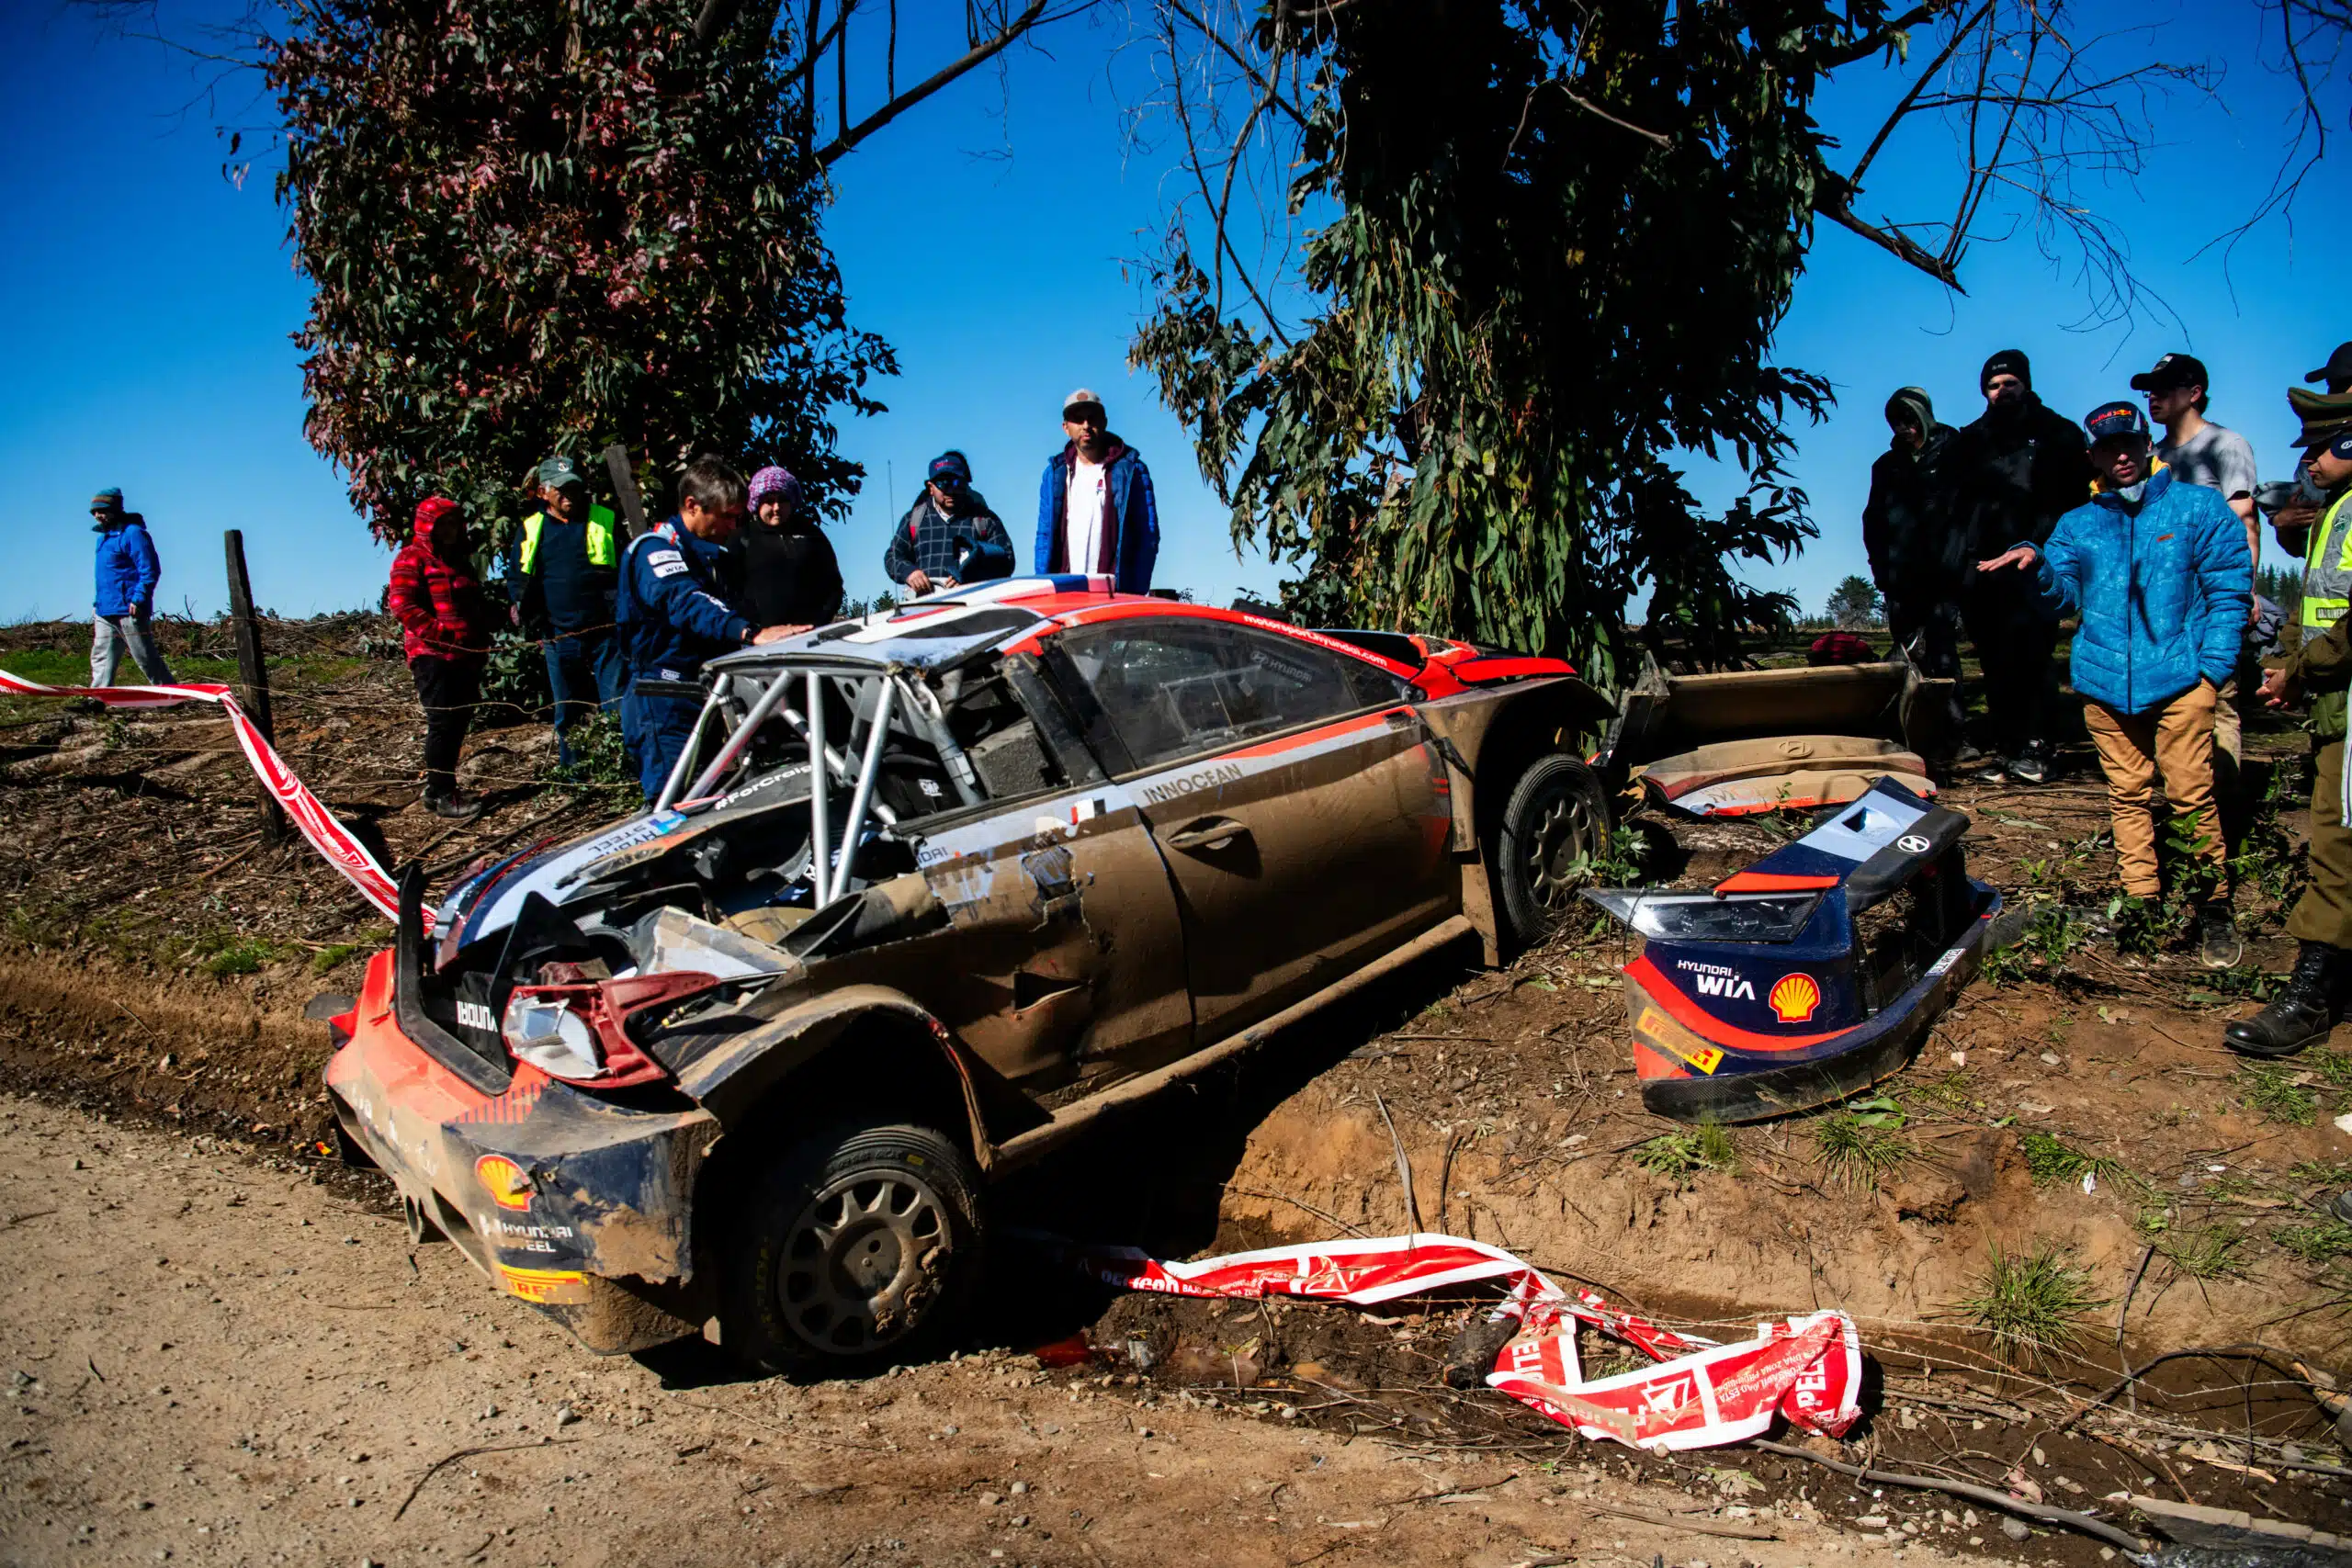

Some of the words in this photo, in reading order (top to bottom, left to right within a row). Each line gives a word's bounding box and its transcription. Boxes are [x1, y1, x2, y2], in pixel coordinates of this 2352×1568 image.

[1243, 615, 1388, 668] motorsport.hyundai.com
[1270, 659, 1313, 682] HYUNDAI
[1142, 763, 1243, 806] INNOCEAN
[1678, 960, 1732, 976] HYUNDAI
[456, 1000, 498, 1032] YUNDAI
[520, 1240, 557, 1253] EEL
[1759, 1362, 1782, 1375] ZONA
[1718, 1389, 1741, 1404] ESTA
